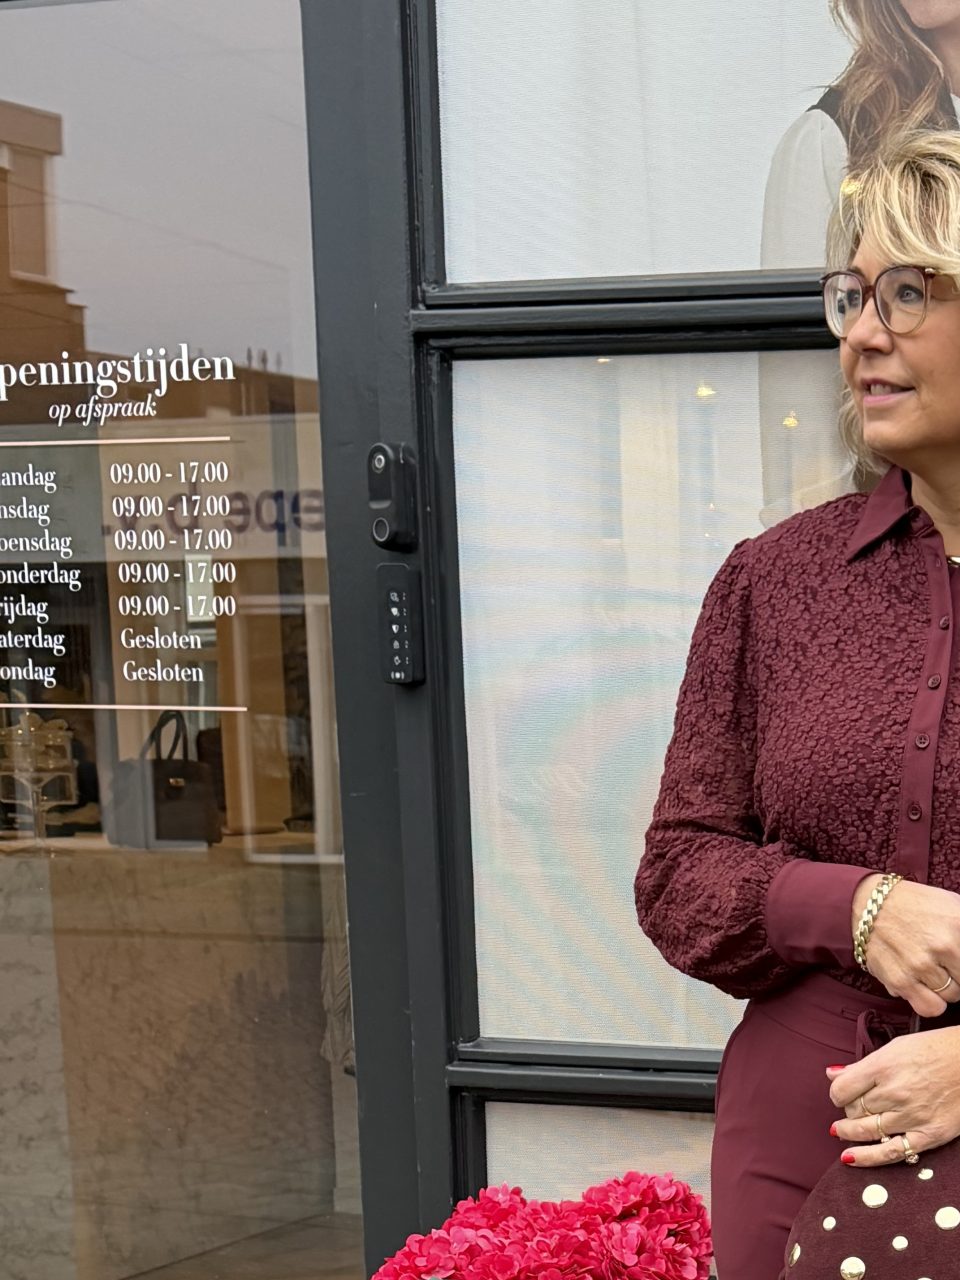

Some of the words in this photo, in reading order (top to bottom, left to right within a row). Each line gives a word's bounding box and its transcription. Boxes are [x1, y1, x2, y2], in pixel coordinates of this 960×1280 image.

[0, 343, 236, 402] peningstijden
[49, 403, 71, 427] op
[75, 393, 157, 427] afspraak
[0, 463, 57, 494] andag
[110, 463, 161, 484] 09.00
[180, 461, 228, 483] 17.00
[112, 496, 163, 518] 09.00
[182, 495, 230, 517] 17.00
[114, 529, 165, 551] 09.00
[184, 528, 232, 550] 17.00
[118, 562, 169, 584] 09.00
[187, 562, 236, 583] 17.00
[118, 595, 169, 617] 09.00
[187, 595, 236, 617] 17.00
[0, 626, 66, 657] aterdag
[120, 626, 202, 649] Gesloten
[0, 658, 56, 689] ondag
[123, 659, 204, 682] Gesloten
